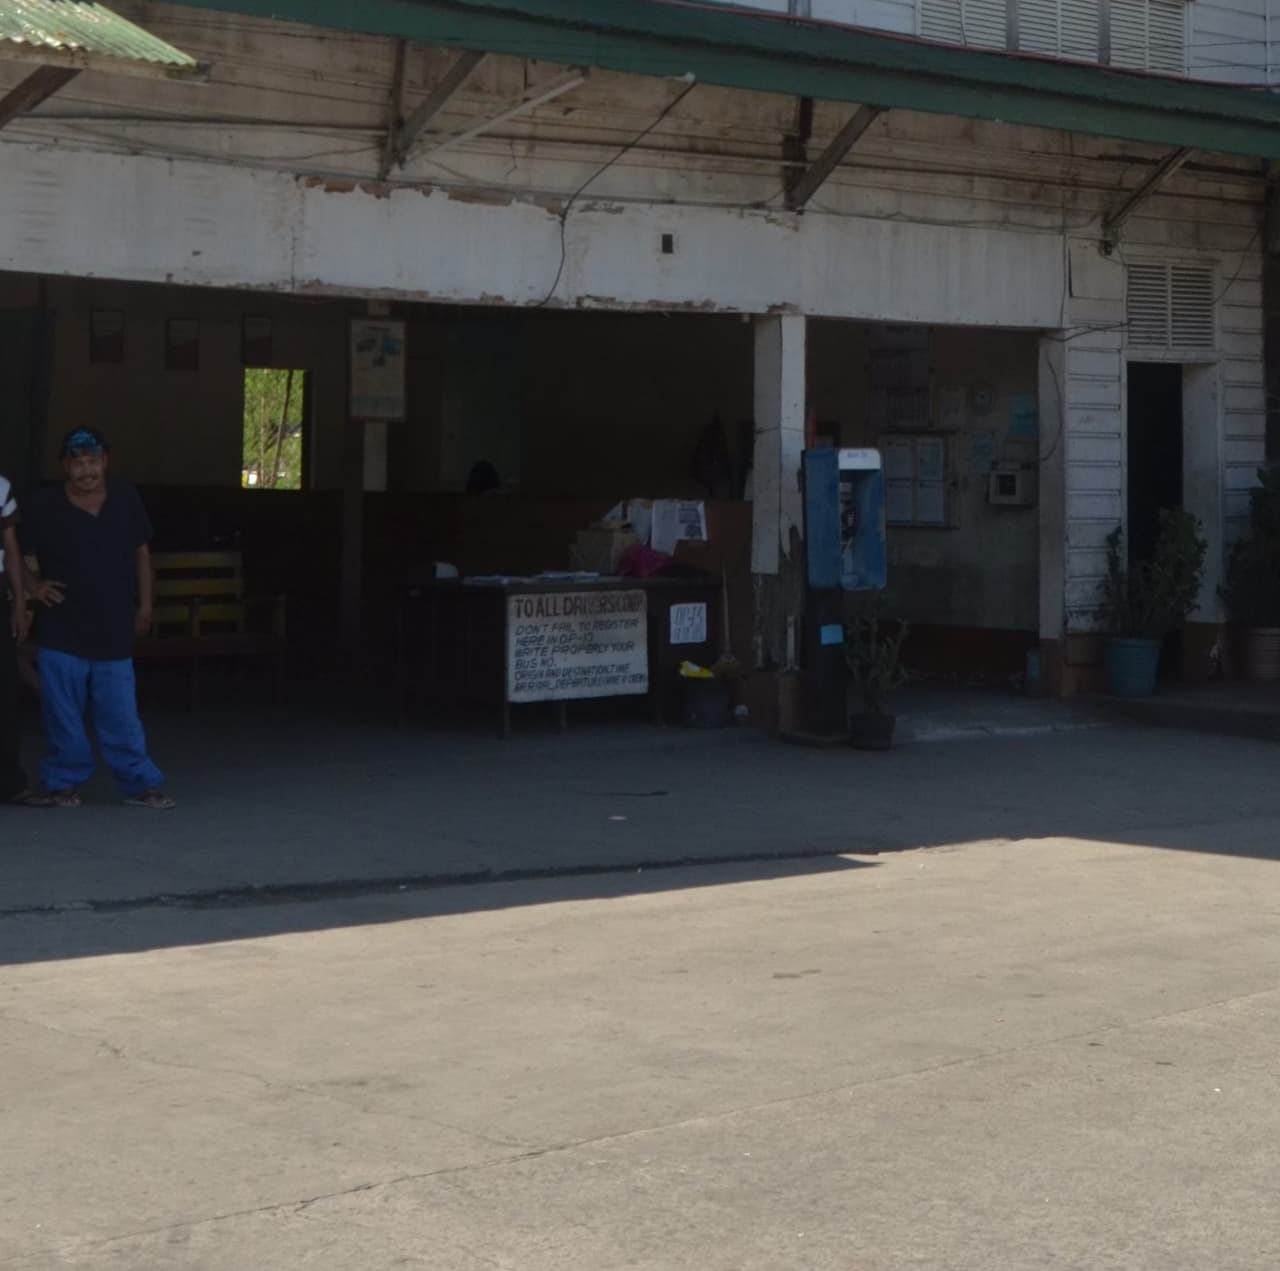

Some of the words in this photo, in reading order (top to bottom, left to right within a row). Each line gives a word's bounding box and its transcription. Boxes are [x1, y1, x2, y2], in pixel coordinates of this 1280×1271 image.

[514, 599, 533, 618] TO
[536, 597, 559, 616] ALL
[515, 659, 538, 669] BUS
